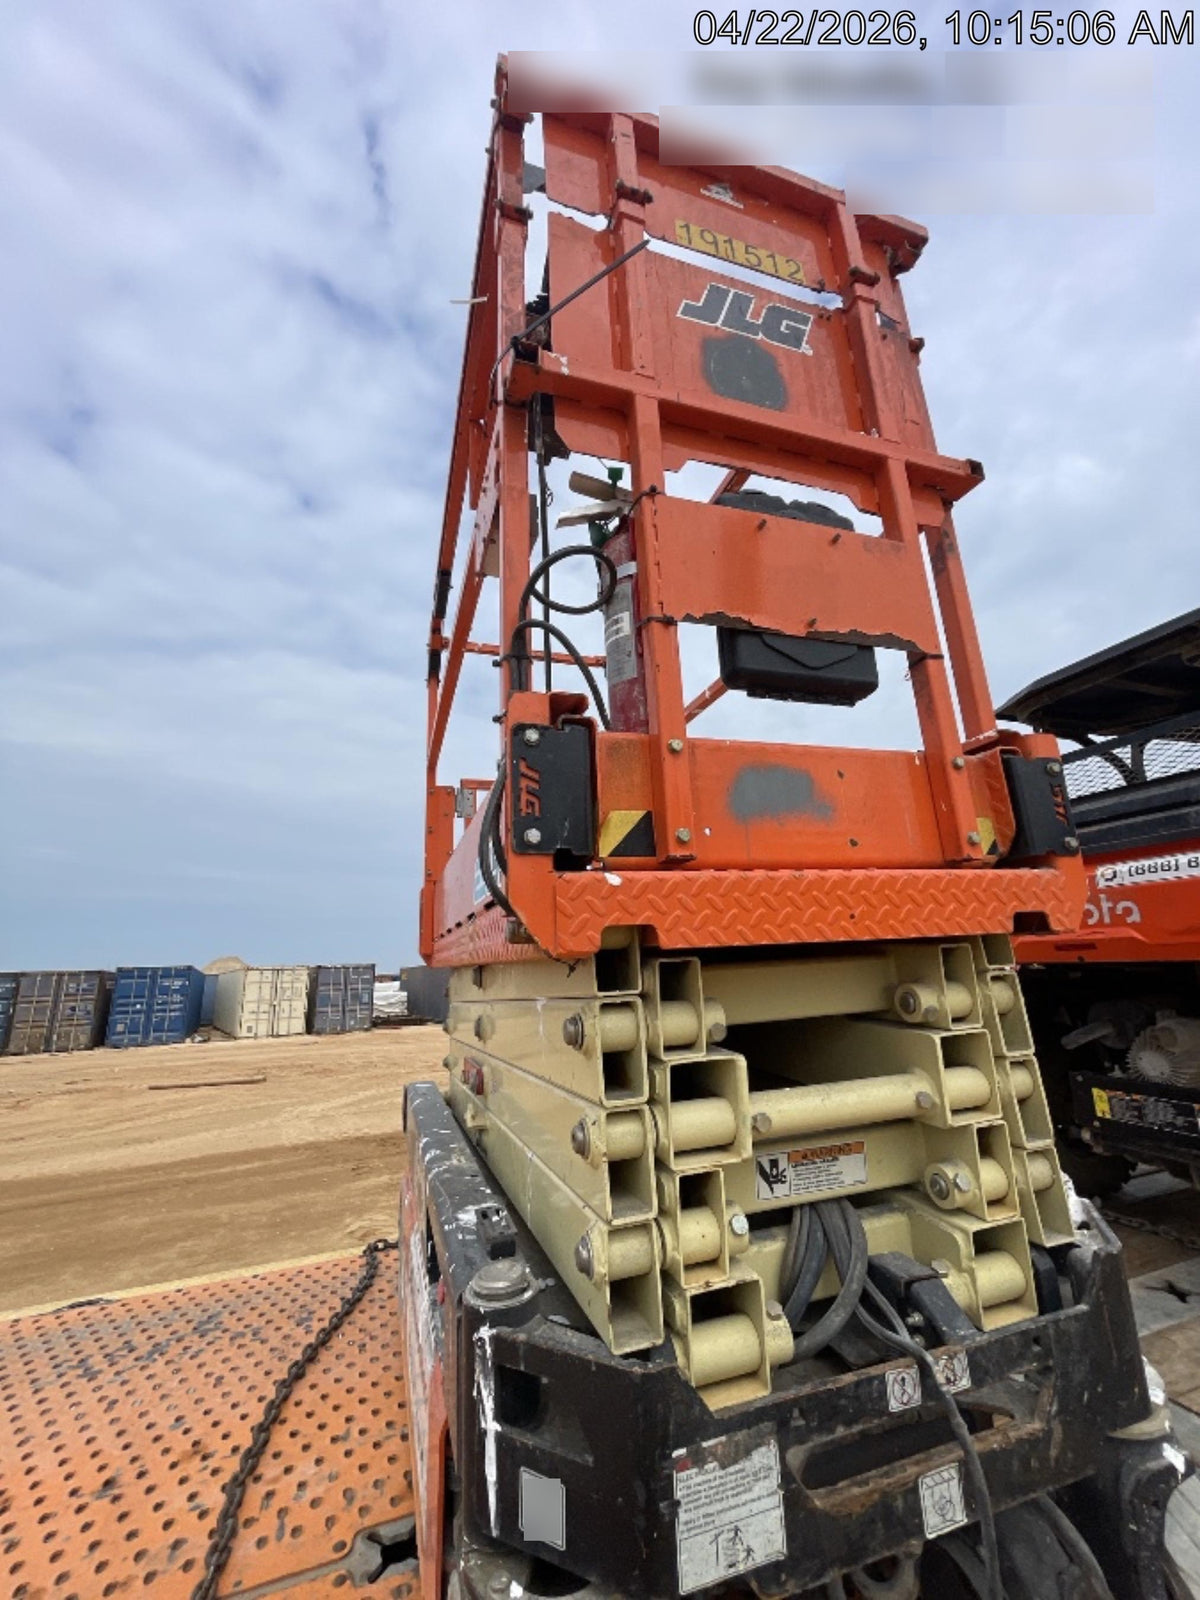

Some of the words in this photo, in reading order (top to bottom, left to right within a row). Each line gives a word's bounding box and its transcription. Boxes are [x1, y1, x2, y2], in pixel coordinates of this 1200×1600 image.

[678, 222, 803, 282] 191512
[676, 282, 813, 353] JLG
[519, 756, 541, 817] JLG
